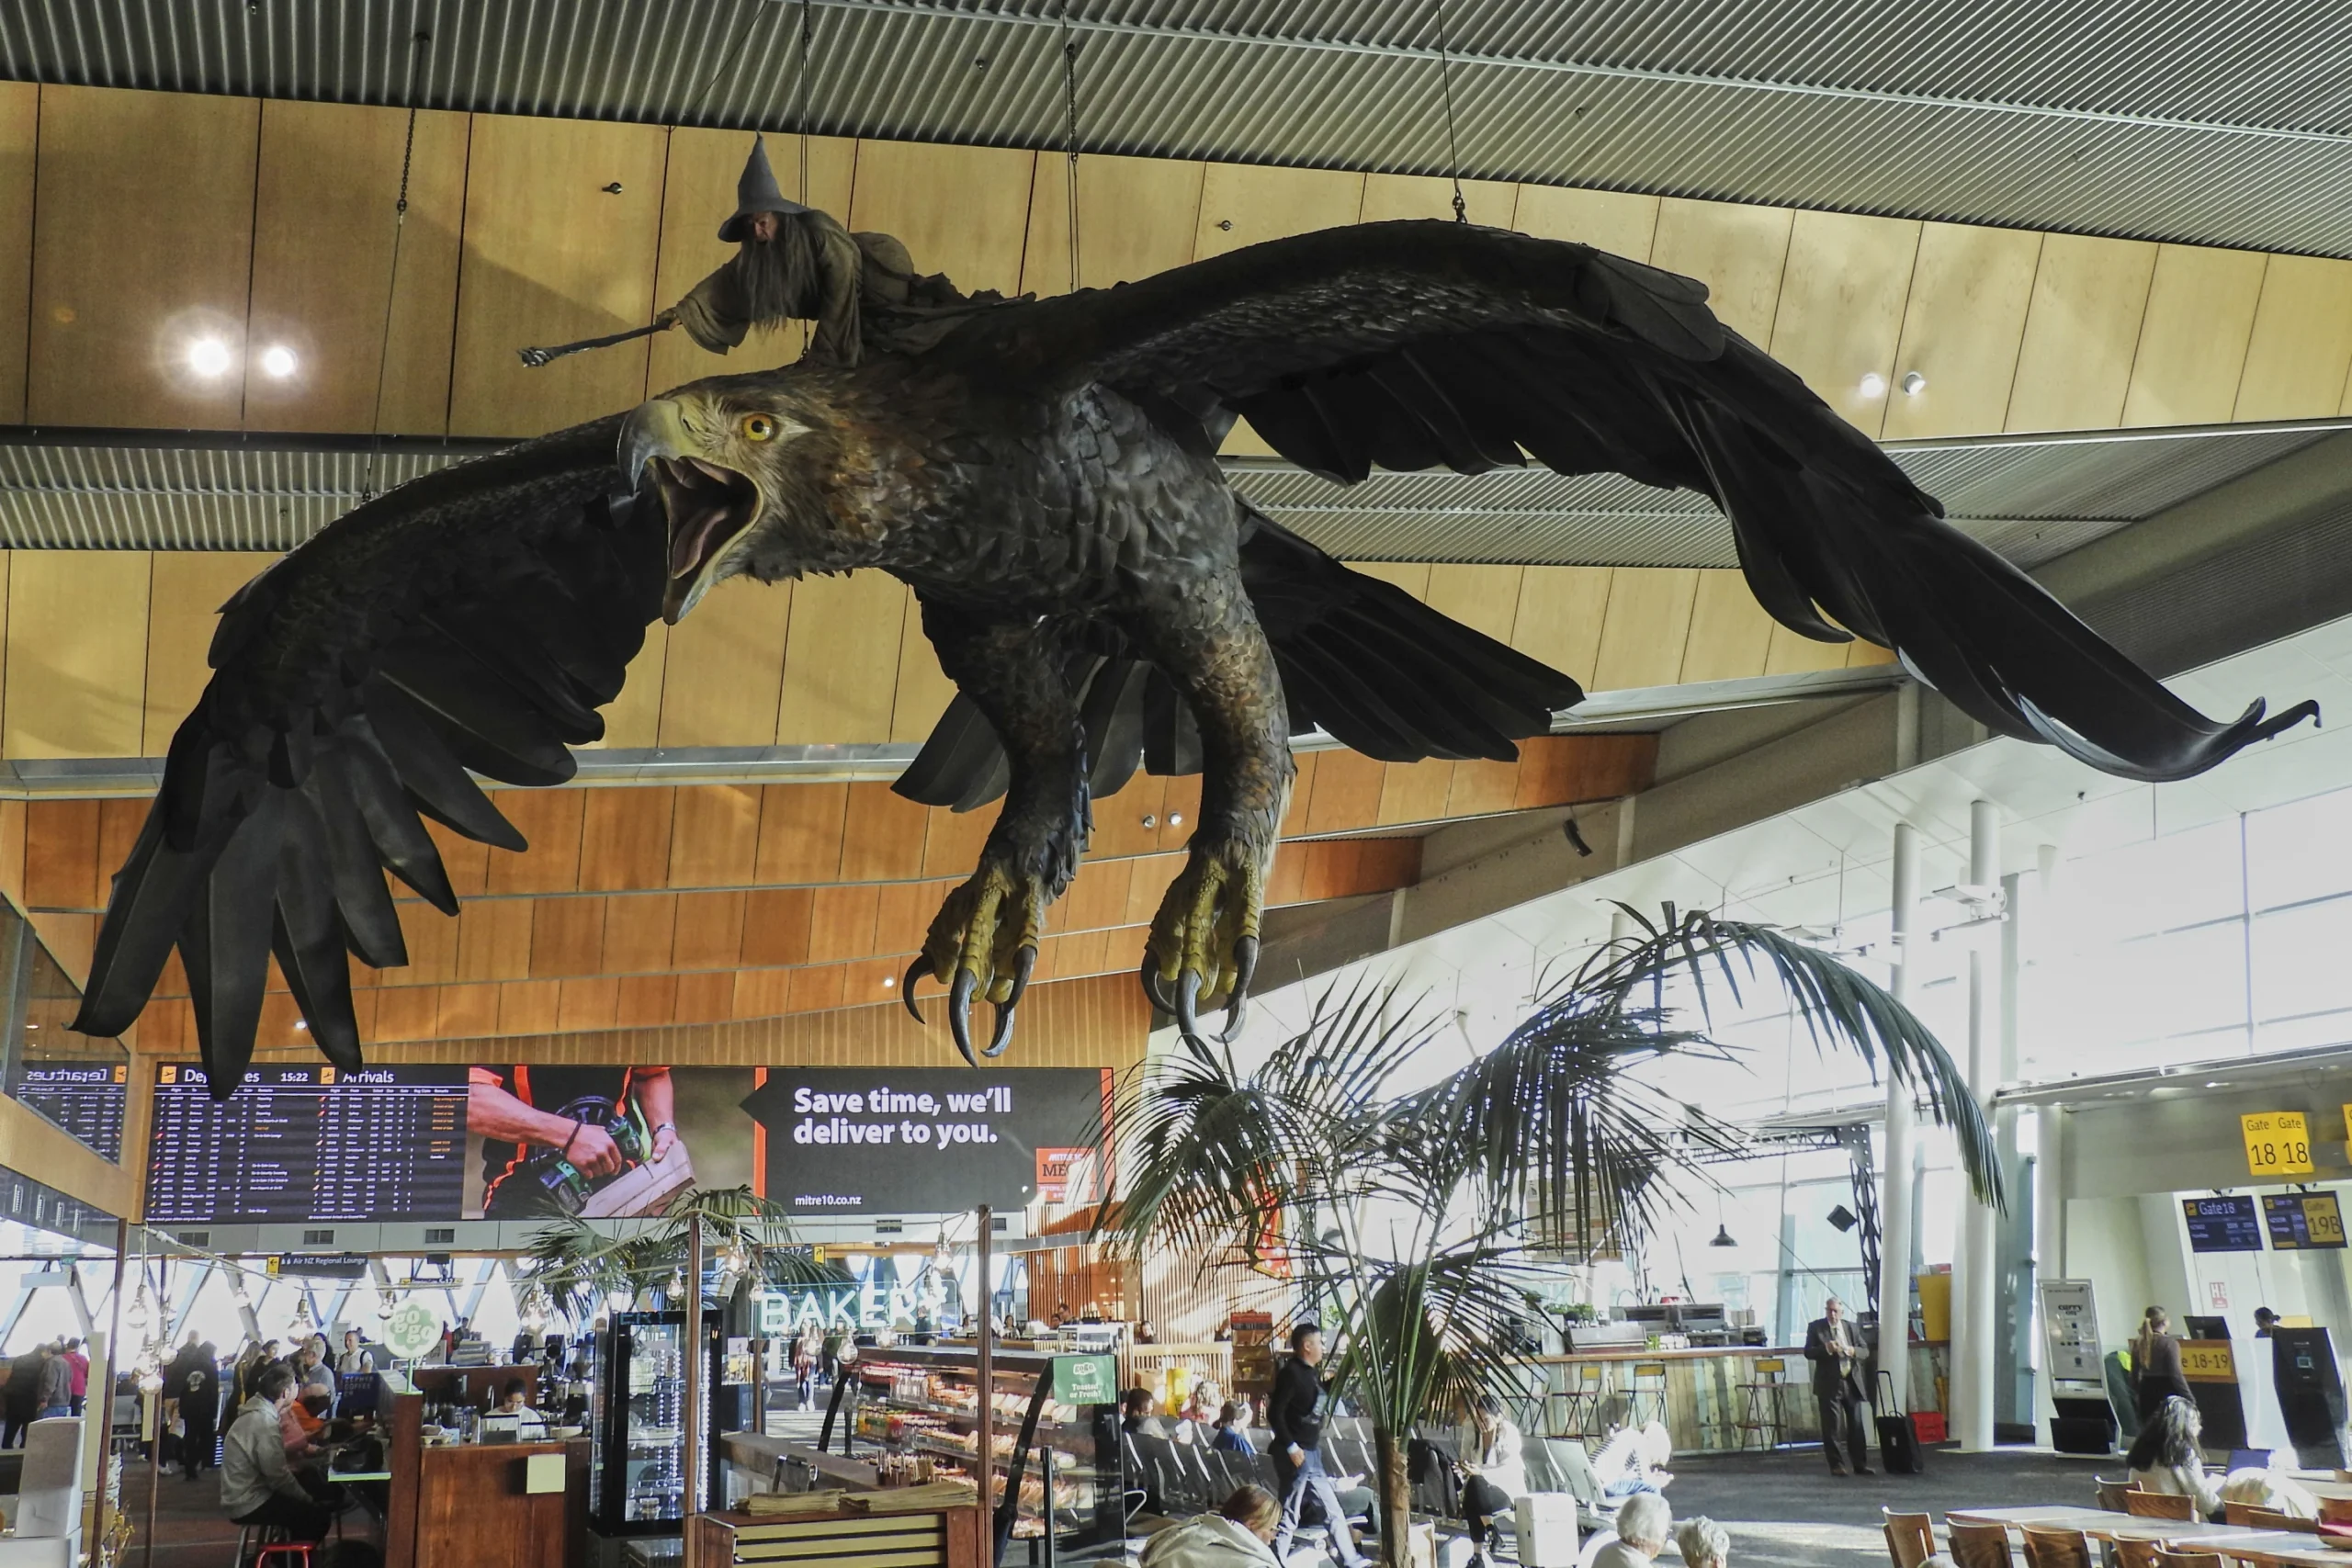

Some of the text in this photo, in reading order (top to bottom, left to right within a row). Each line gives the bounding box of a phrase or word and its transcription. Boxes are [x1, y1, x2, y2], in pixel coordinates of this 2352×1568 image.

[280, 1071, 309, 1083] 15:22
[794, 1087, 1012, 1117] Save time, we'll
[2246, 1119, 2270, 1132] Gate
[2278, 1117, 2301, 1129] Gate
[793, 1117, 999, 1151] deliver to you.
[2251, 1143, 2277, 1166] 18
[2282, 1142, 2308, 1164] 18
[794, 1194, 862, 1207] mitre10.co.nz
[2308, 1215, 2342, 1235] 19B
[292, 1257, 367, 1266] Air NZ Regional Lounge
[760, 1285, 949, 1332] BAKERY
[2191, 1353, 2229, 1370] 18-19
